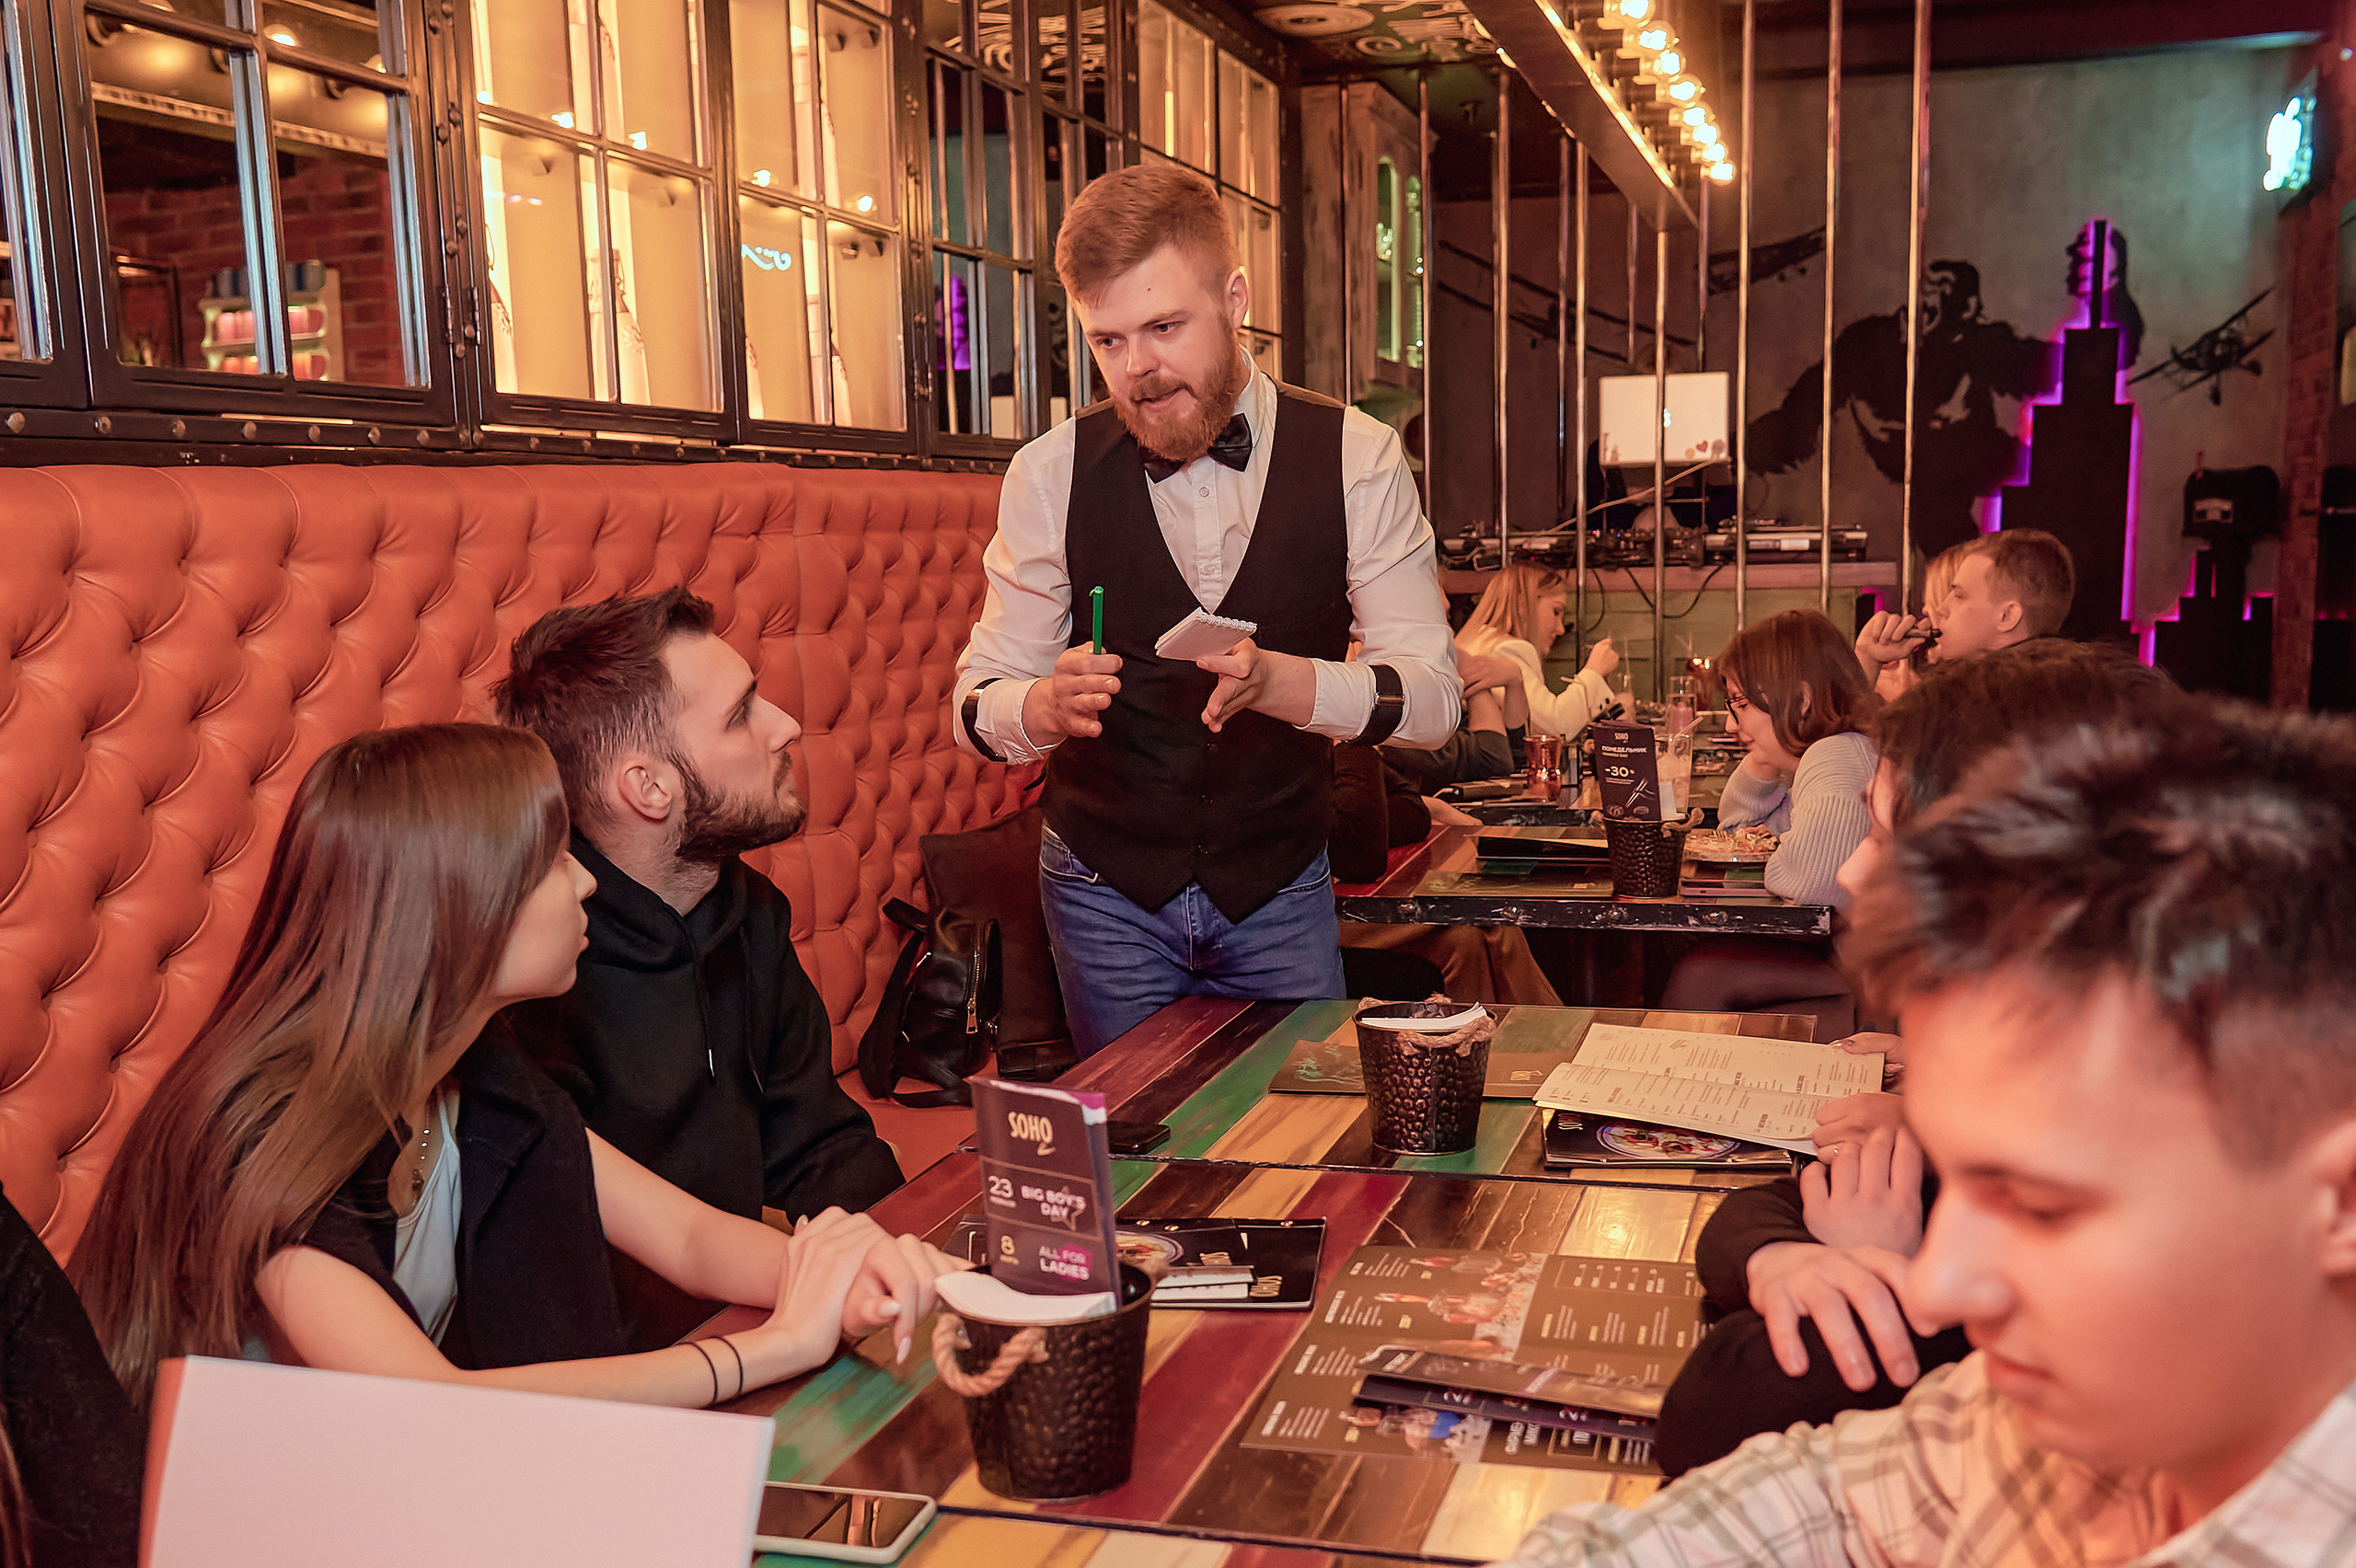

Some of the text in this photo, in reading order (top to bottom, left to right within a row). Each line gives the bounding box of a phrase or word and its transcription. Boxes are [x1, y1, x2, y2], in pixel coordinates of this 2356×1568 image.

[1601, 745, 1647, 754] ПОНЕДЕЛЬНИК
[1008, 1111, 1054, 1144] SOHO
[1558, 1113, 1584, 1131] SOHO
[988, 1175, 1014, 1198] 23
[1021, 1184, 1045, 1202] BIG
[1040, 1202, 1069, 1219] DAY
[1000, 1235, 1015, 1255] 8
[1061, 1250, 1087, 1264] FOR
[1039, 1257, 1091, 1281] LADIES
